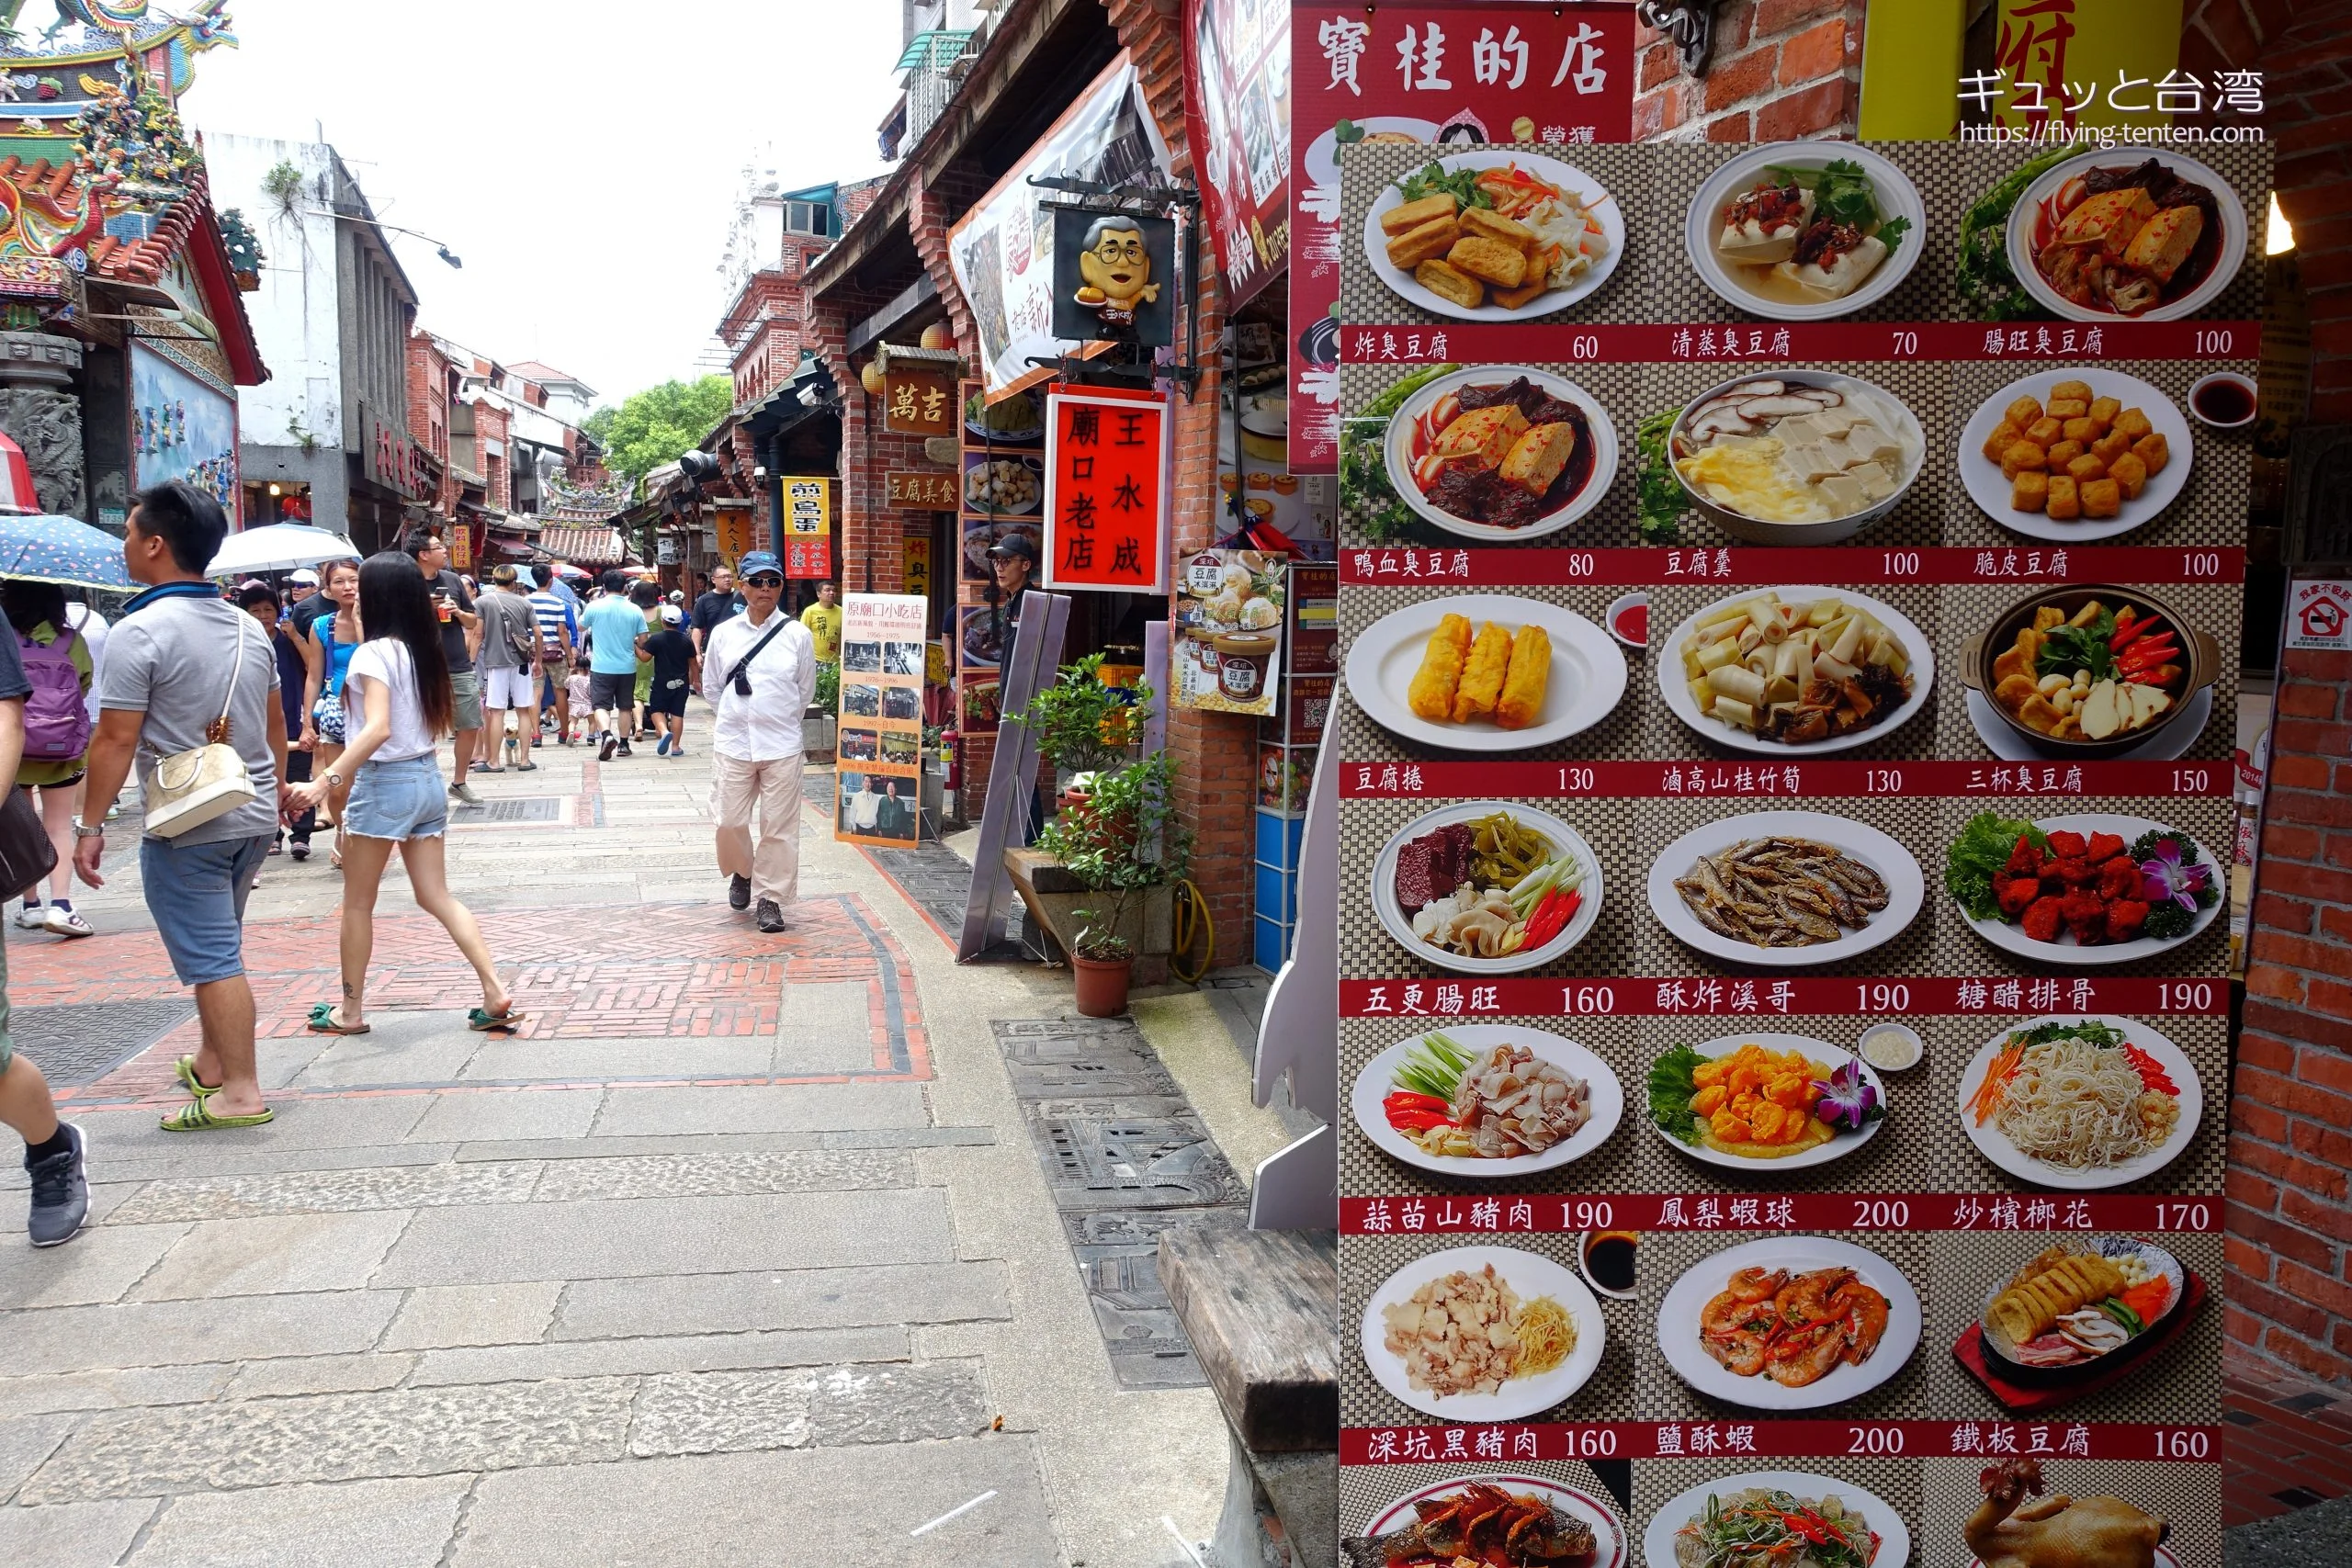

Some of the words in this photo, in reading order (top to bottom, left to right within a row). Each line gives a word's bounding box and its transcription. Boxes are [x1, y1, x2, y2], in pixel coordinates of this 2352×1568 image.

[1317, 16, 1609, 96] 寶桂的店
[1541, 125, 1596, 143] 榮獲
[1353, 330, 1448, 361] 炸臭豆腐
[1573, 335, 1599, 359] 60
[1671, 326, 1791, 358] 清蒸臭豆腐
[1893, 332, 1917, 355] 70
[1982, 325, 2103, 355] 腸旺臭豆腐
[2196, 330, 2233, 354] 100
[889, 382, 947, 423] 萬吉
[890, 479, 957, 503] 豆腐美食
[1063, 406, 1101, 571] 廟口老店
[1110, 412, 1147, 576] 王水成
[1194, 568, 1217, 581] 豆腐
[1354, 549, 1469, 579] 鴨血臭豆腐
[1568, 553, 1594, 577] 80
[1664, 548, 1732, 578] 豆腐羹
[1883, 552, 1919, 575] 100
[1973, 547, 2068, 578] 脆皮豆腐
[2183, 553, 2219, 576] 100
[1194, 581, 1216, 589] 冰淇淋
[847, 602, 922, 619] 原廟口小吃店
[1227, 671, 1250, 682] 豆腐
[1227, 682, 1250, 690] 冰淇淋
[1354, 763, 1425, 792] 豆腐捲
[1558, 768, 1594, 791] 130
[1662, 765, 1800, 794] 滷高山桂竹筍
[1866, 770, 1902, 793] 130
[1966, 764, 2083, 793] 三杯臭豆腐
[2173, 770, 2209, 792] 150
[1362, 984, 1500, 1016] 五更腸旺
[1561, 987, 1614, 1013] 160
[1657, 978, 1796, 1013] 酥炸溪哥
[1857, 984, 1910, 1011] 190
[1955, 977, 2096, 1012] 糖醋排骨
[2158, 983, 2211, 1010] 190
[1361, 1198, 1532, 1232] 蒜苗山豬肉
[1561, 1201, 1614, 1229] 190
[1656, 1192, 1797, 1229] 鳳梨蝦球
[1853, 1201, 1910, 1228] 200
[1952, 1196, 2093, 1231] 炒檳榔花
[2155, 1203, 2210, 1231] 170
[1368, 1426, 1539, 1461] 深坑黑豬肉
[1565, 1429, 1617, 1456] 160
[1653, 1420, 1758, 1456] 鹽酥蝦
[1848, 1427, 1904, 1454] 200
[1950, 1423, 2090, 1457] 鐵板豆腐
[2154, 1430, 2209, 1458] 160
